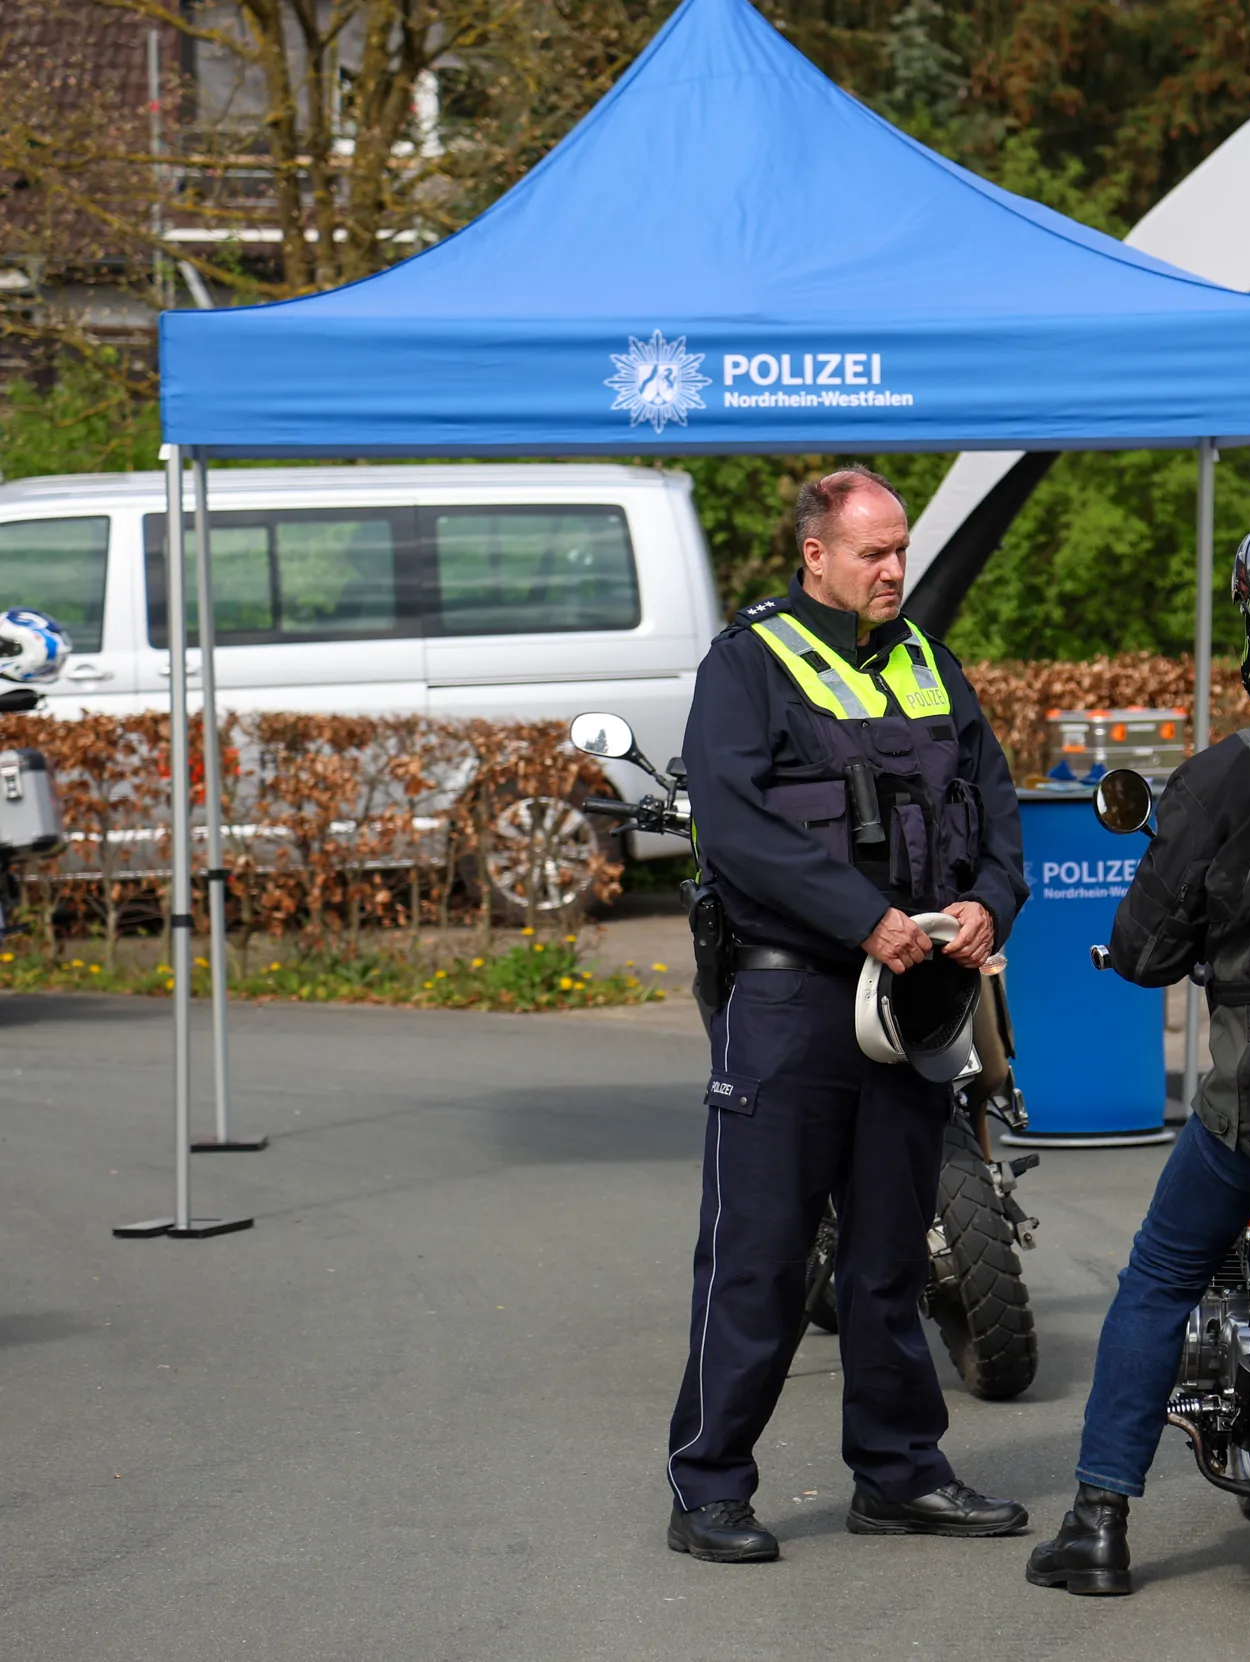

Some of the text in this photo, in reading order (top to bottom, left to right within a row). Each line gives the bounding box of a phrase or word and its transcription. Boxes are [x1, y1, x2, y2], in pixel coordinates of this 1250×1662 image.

[723, 353, 882, 386] POLIZEI
[723, 390, 914, 408] Nordrhein-Westfalen
[905, 689, 948, 710] POLIZEI
[1042, 858, 1142, 885] POLIZE
[711, 1081, 734, 1096] POLIZEI
